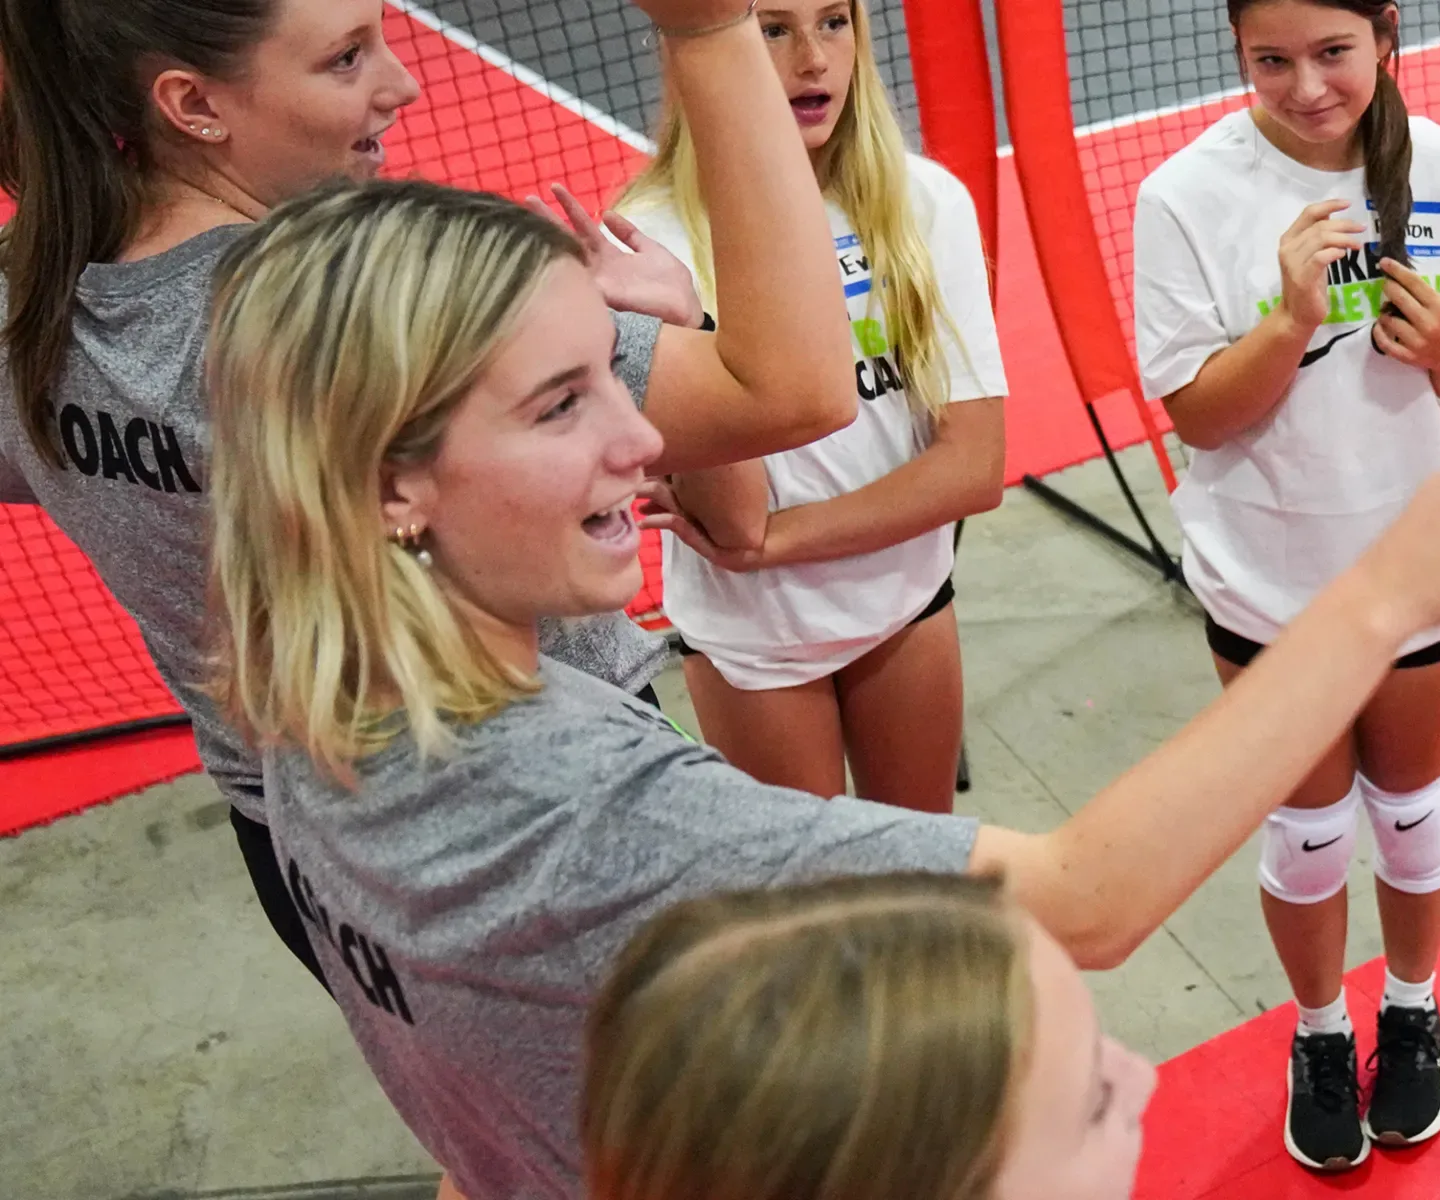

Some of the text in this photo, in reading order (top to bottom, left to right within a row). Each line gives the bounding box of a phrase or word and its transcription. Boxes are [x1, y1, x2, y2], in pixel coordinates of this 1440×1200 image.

[1327, 242, 1386, 286] IKE
[855, 356, 904, 401] CA
[59, 402, 203, 493] OACH
